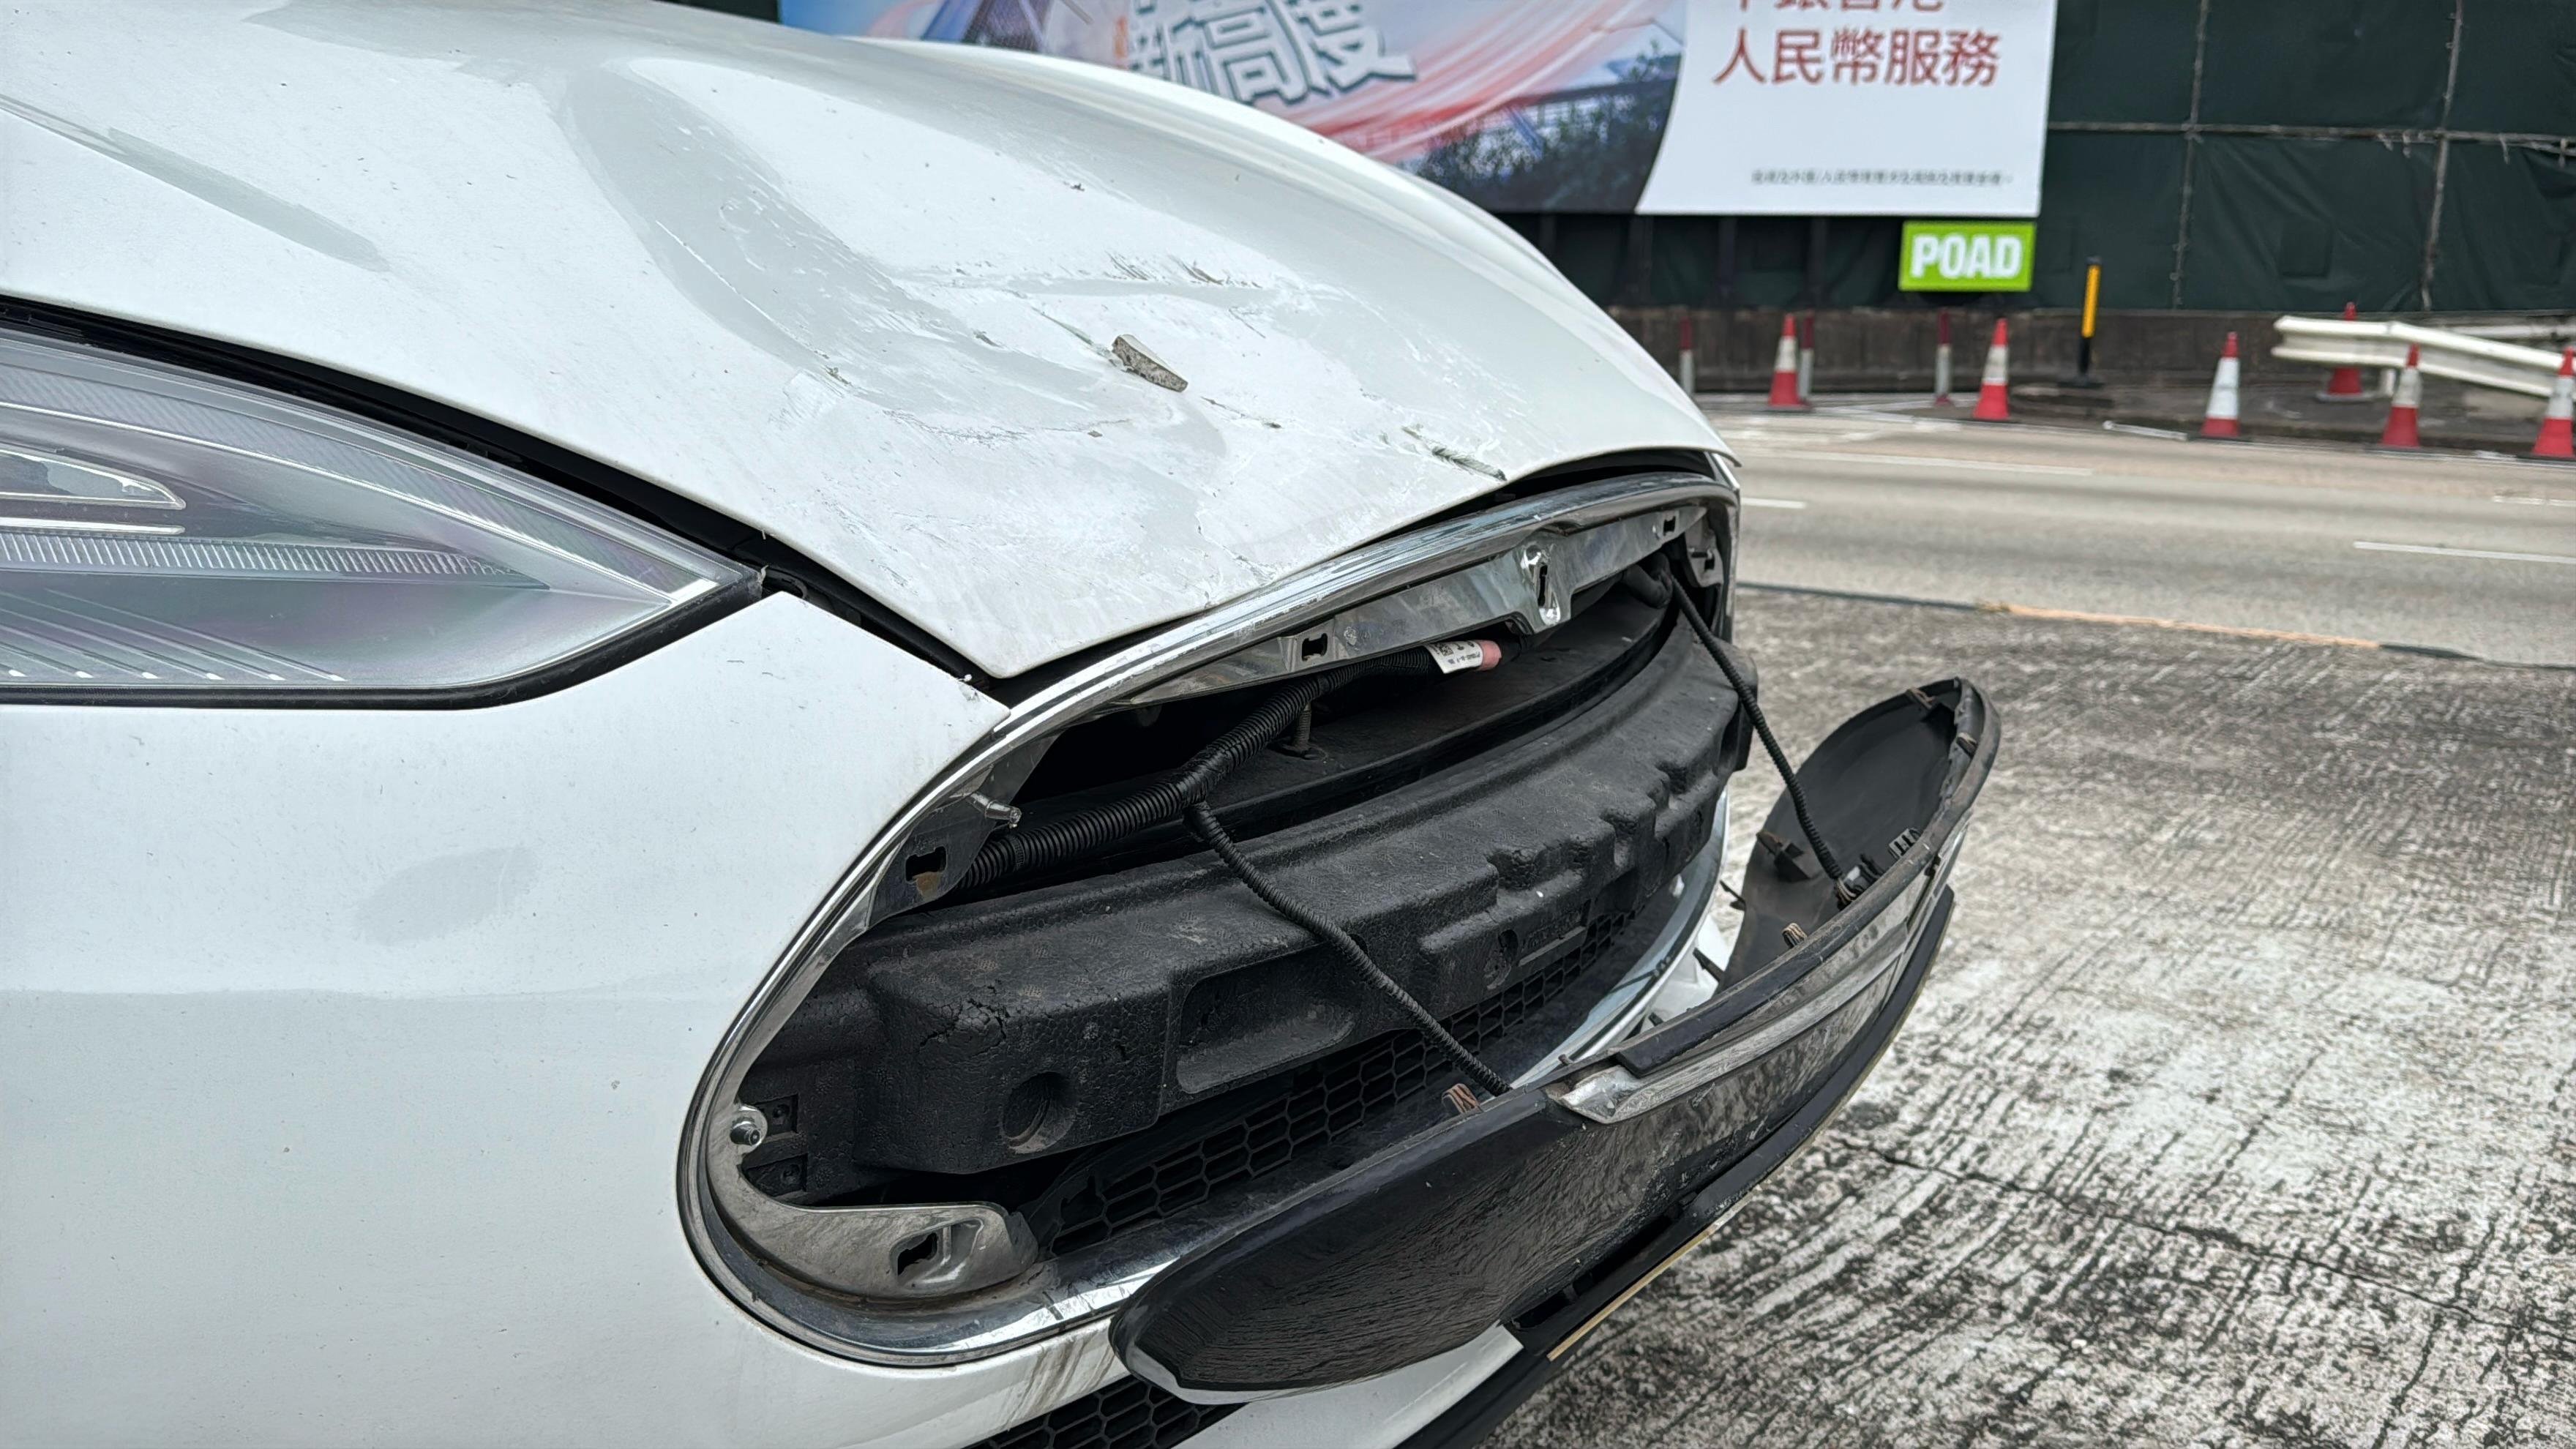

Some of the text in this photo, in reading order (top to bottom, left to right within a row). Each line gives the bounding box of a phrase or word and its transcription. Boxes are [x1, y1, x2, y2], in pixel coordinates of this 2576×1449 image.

[1712, 26, 2000, 86] 人民幣服務
[1910, 233, 2022, 278] POAD
